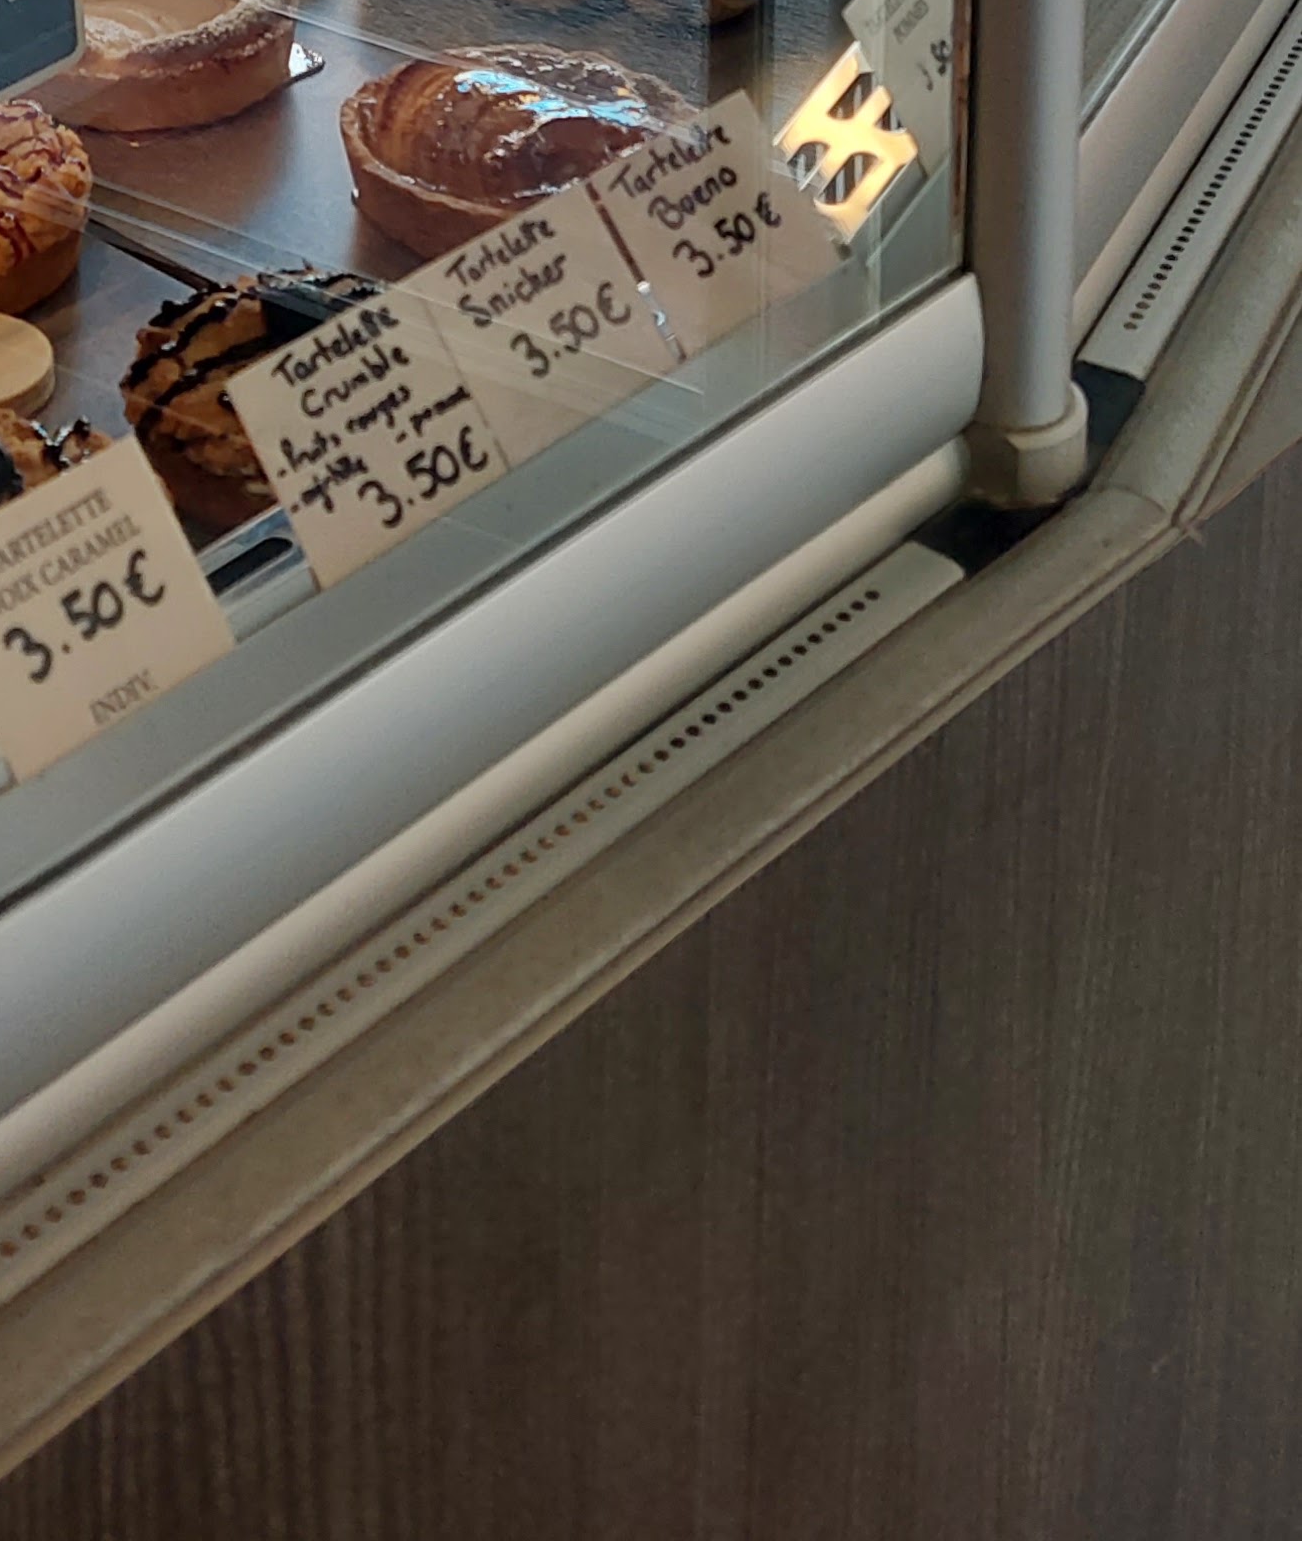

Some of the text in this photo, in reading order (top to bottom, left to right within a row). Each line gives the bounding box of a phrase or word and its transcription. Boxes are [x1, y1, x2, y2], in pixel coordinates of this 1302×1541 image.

[445, 220, 556, 286] Tartelette
[457, 253, 566, 329] Snicker
[271, 307, 400, 387] Tartelette
[301, 345, 410, 418] Crumble
[357, 425, 489, 529] 3.50€
[38, 513, 142, 596] CARAMEL
